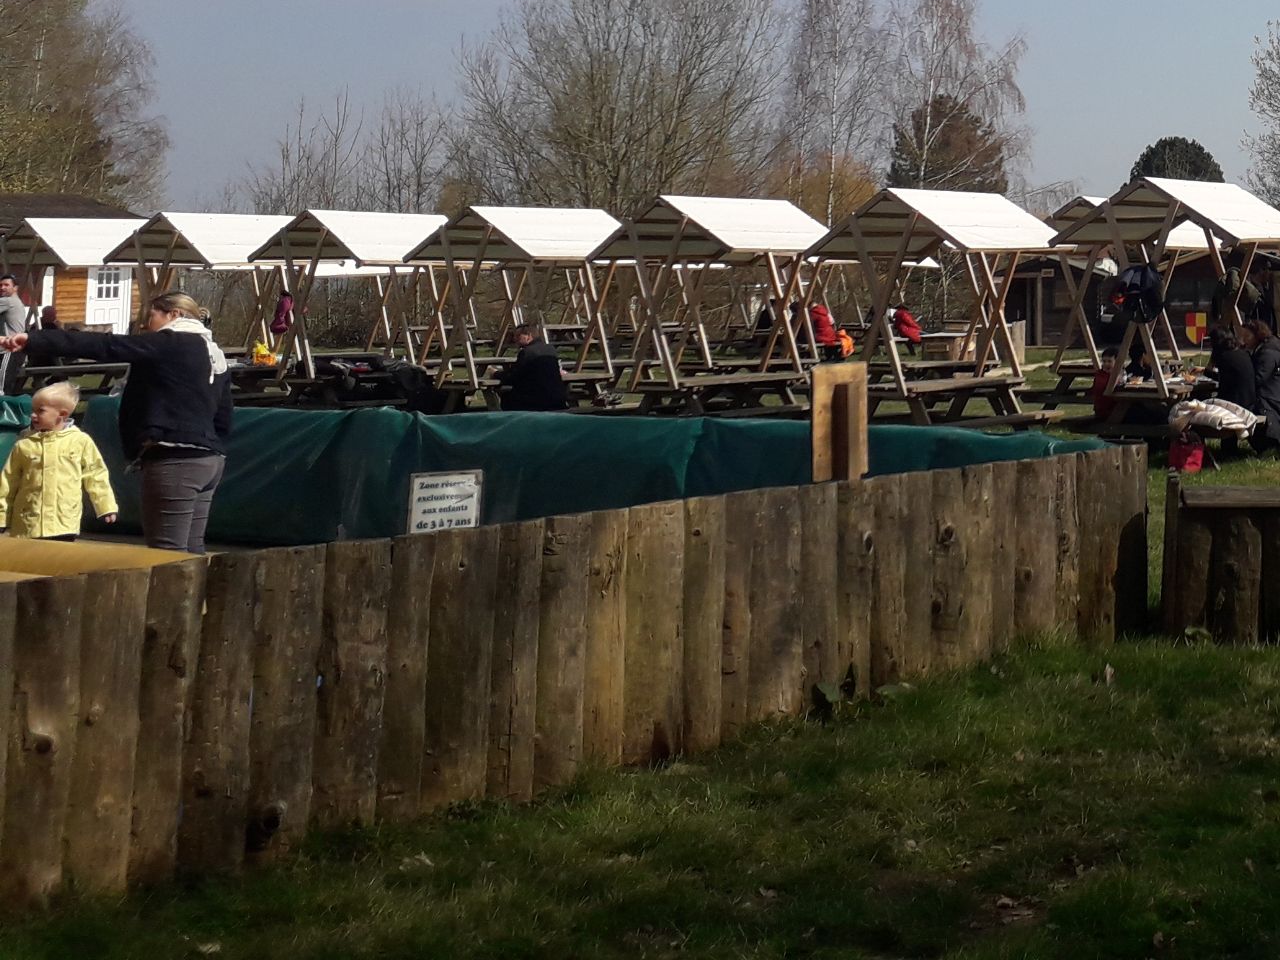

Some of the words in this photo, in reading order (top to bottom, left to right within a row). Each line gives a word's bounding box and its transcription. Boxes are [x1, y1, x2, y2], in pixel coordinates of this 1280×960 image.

[419, 482, 439, 490] Zone
[438, 505, 468, 513] enfants
[416, 520, 428, 529] de
[430, 520, 437, 529] 3
[438, 518, 445, 527] à
[447, 519, 453, 528] 7
[454, 517, 471, 525] ans
